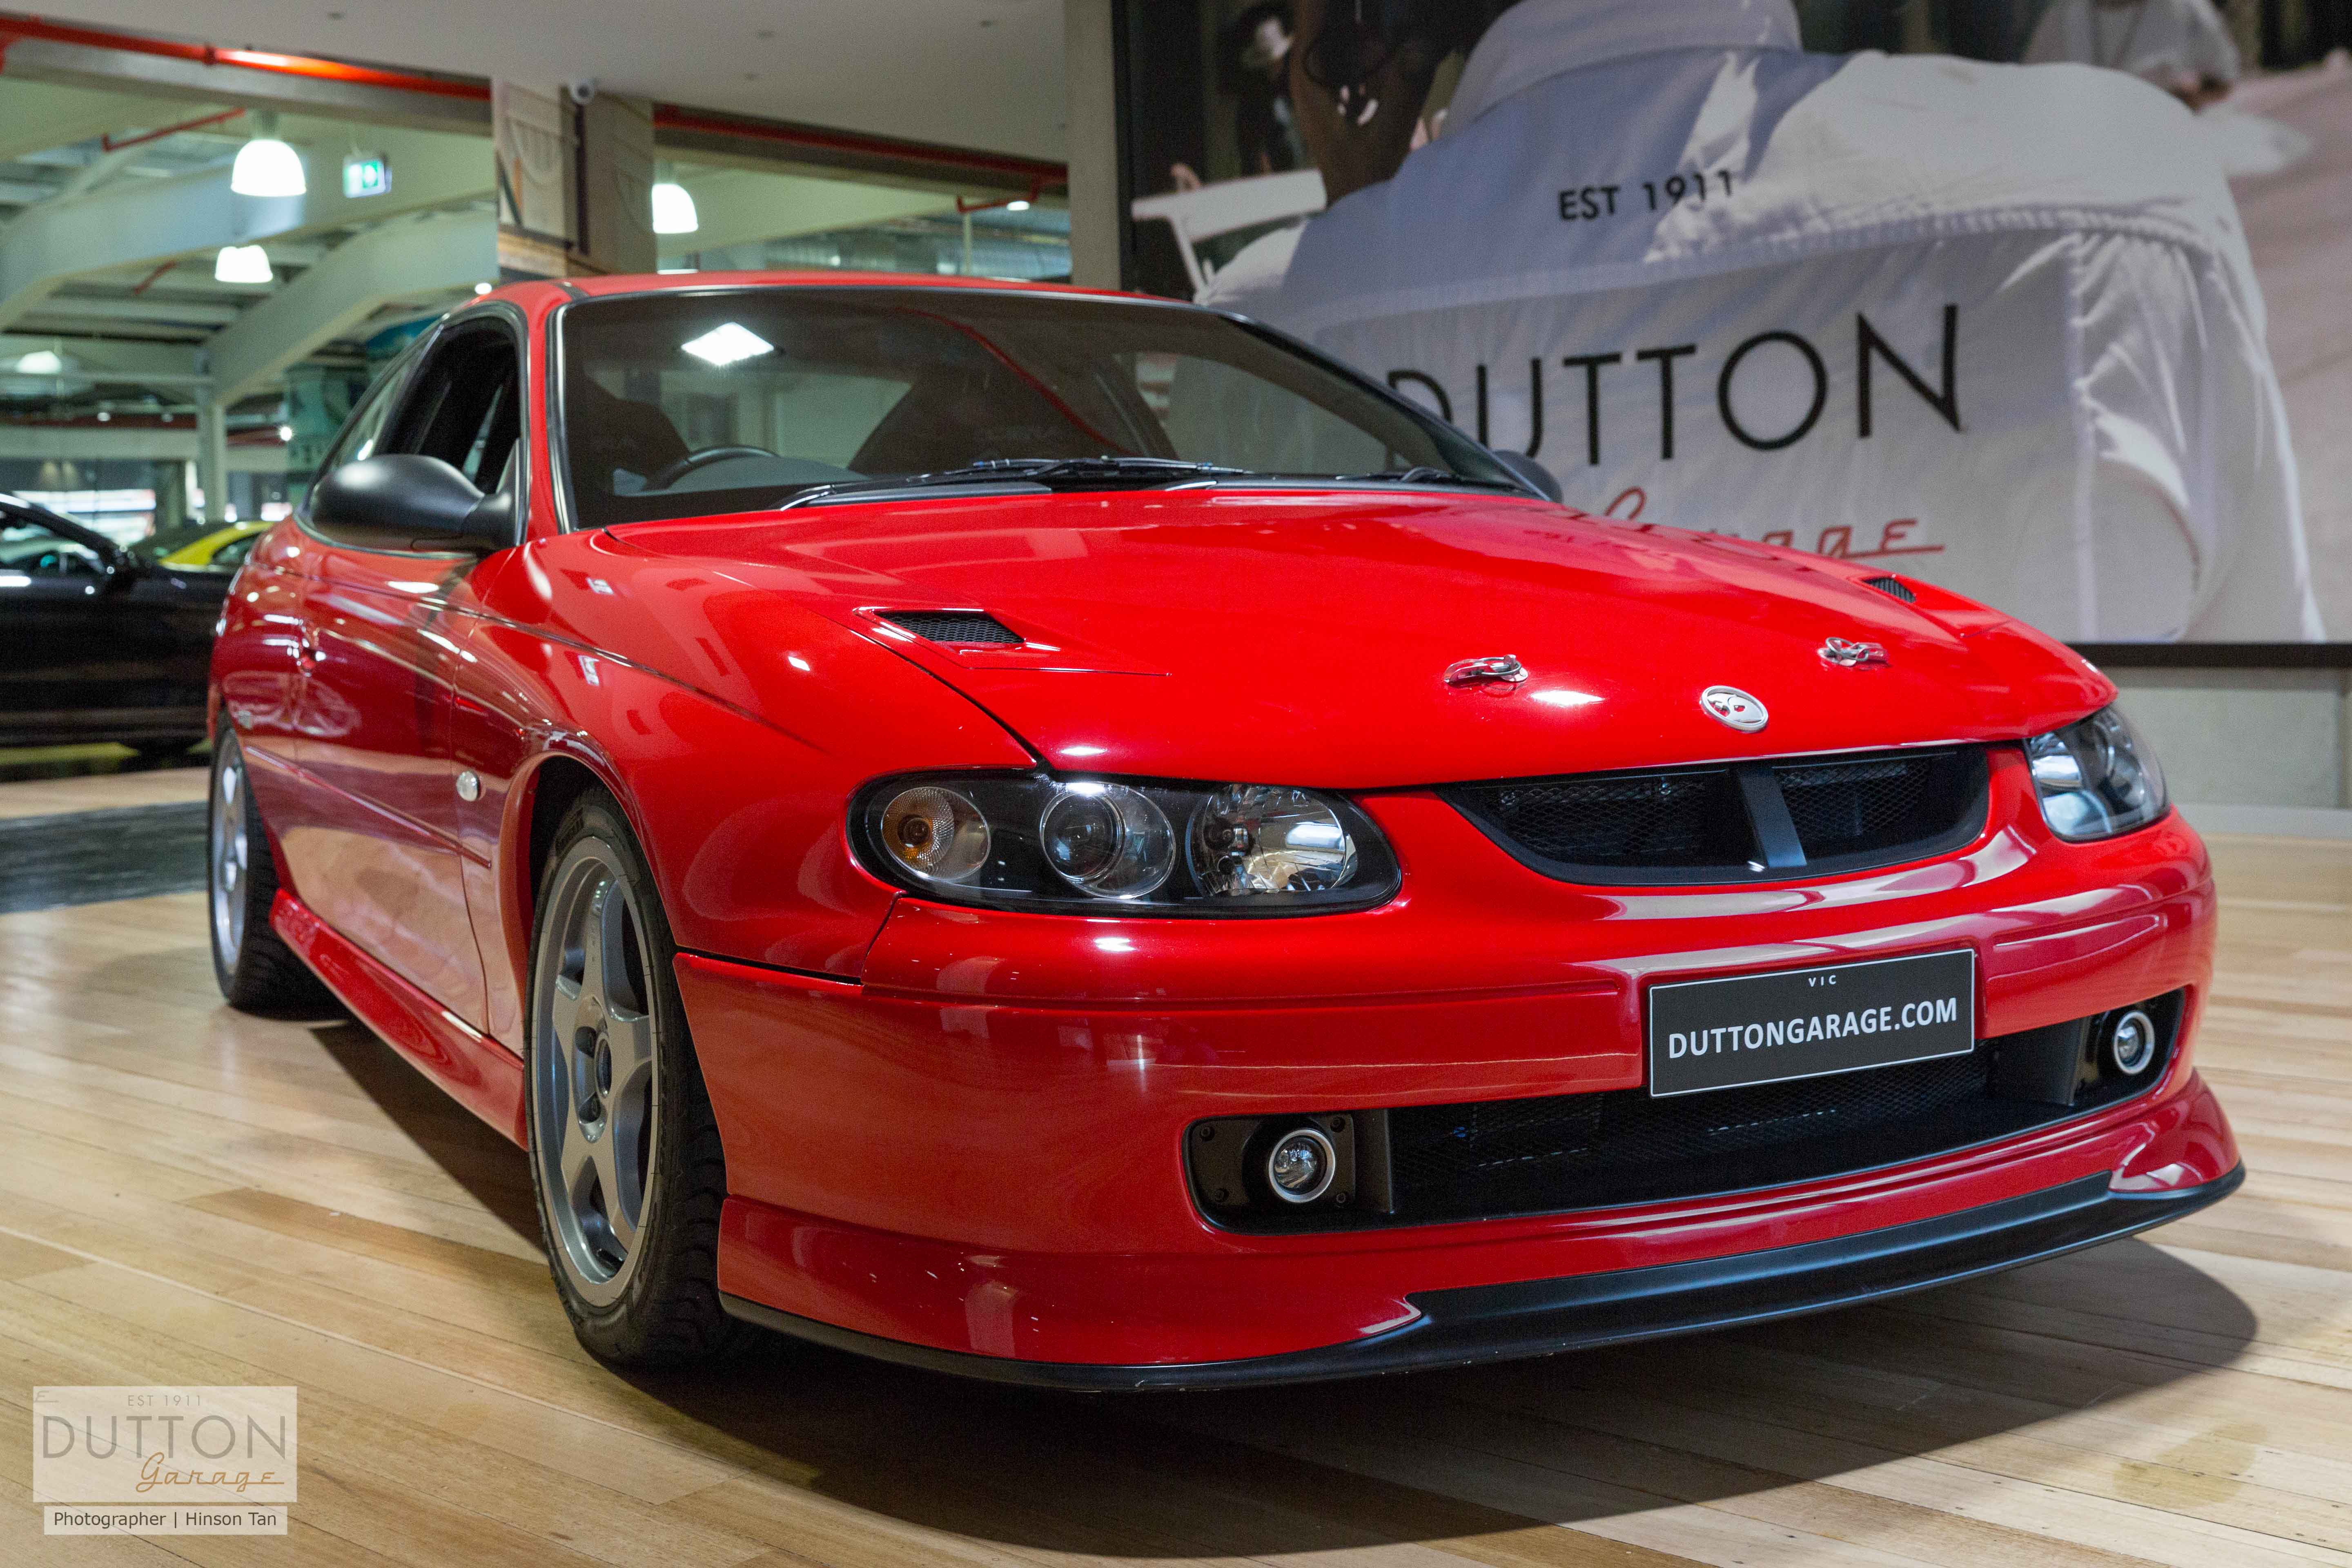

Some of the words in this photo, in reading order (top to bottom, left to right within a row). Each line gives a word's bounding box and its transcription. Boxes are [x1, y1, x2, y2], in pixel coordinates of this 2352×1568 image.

[1558, 185, 1620, 221] EST
[1642, 169, 1732, 210] 1911
[1808, 974, 1837, 987] VIC
[1668, 997, 1958, 1059] DUTTONGARAGE.COM
